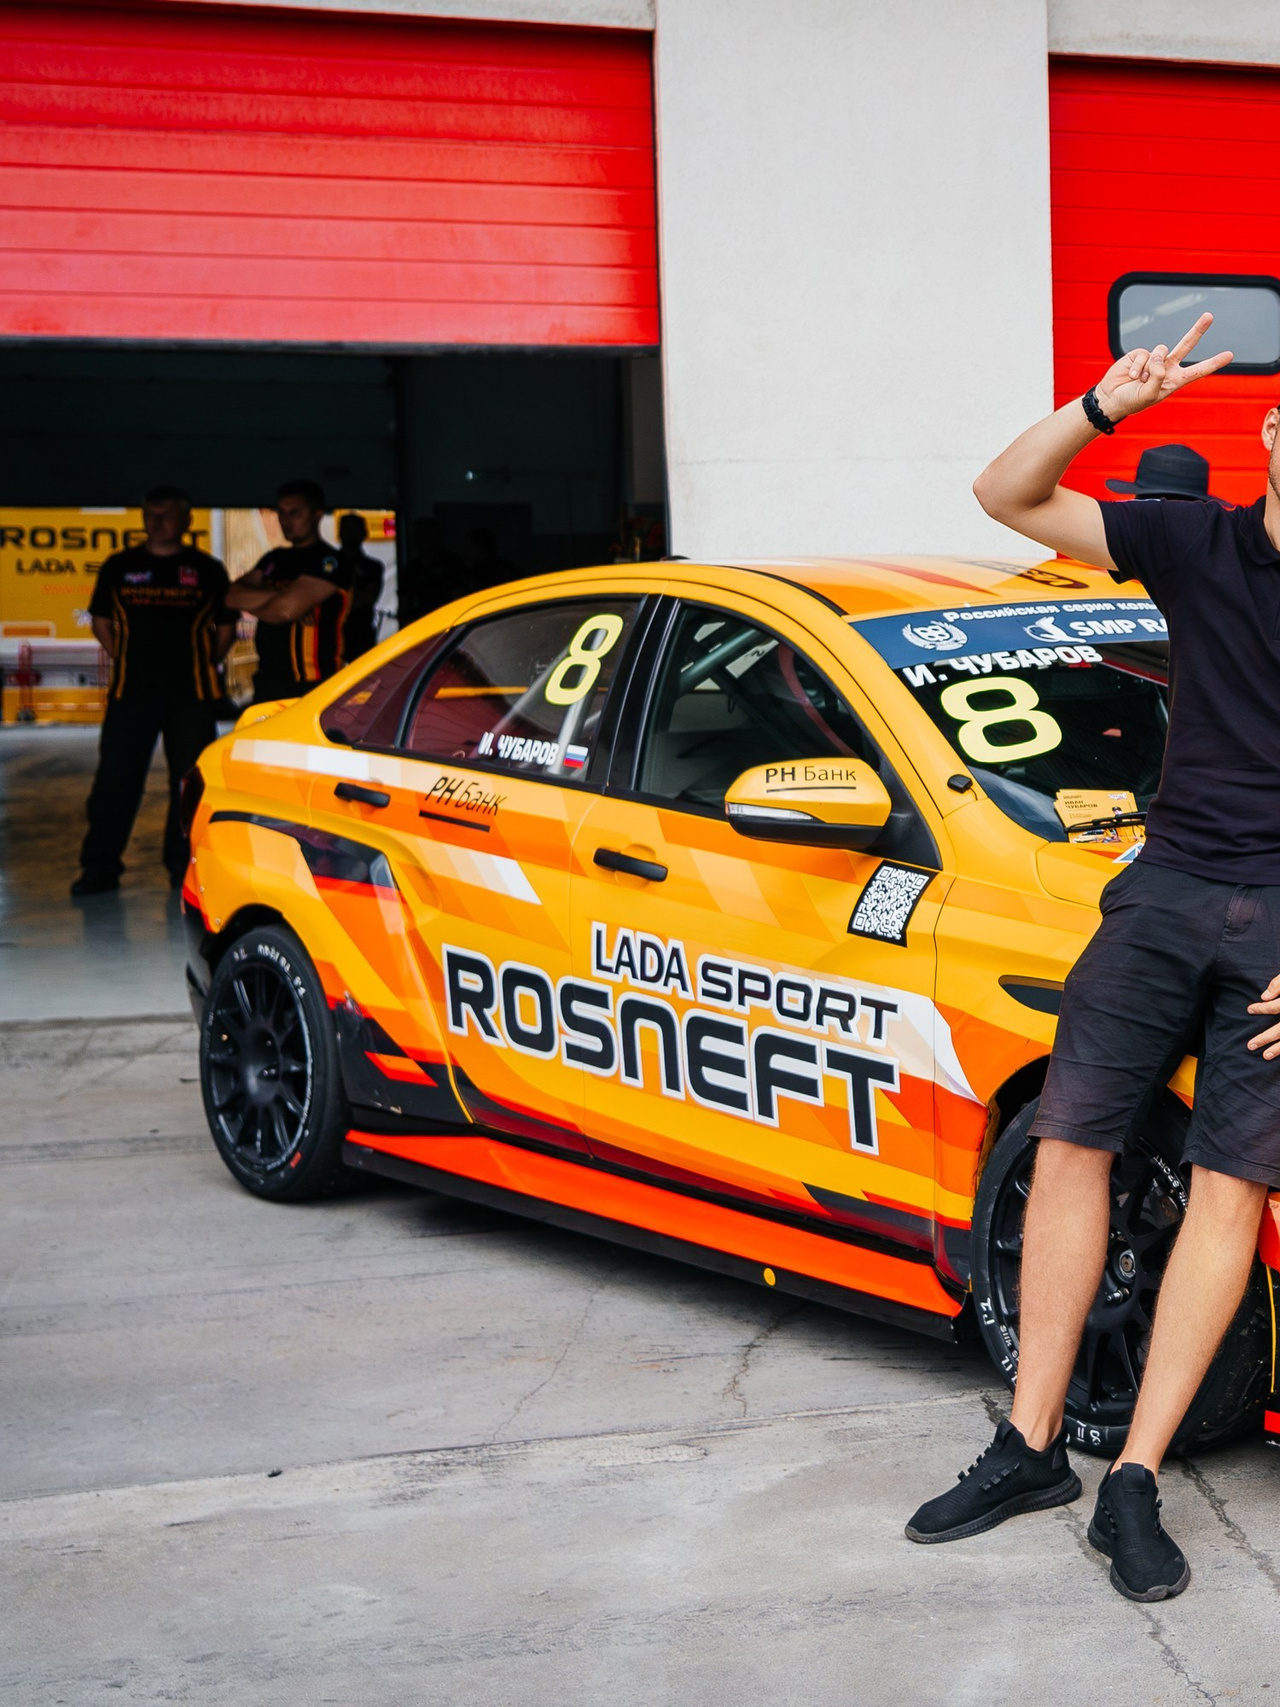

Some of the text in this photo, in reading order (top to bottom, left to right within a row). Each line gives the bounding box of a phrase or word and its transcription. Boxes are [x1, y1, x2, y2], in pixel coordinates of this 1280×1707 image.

[0, 526, 208, 550] ROSNET
[16, 558, 77, 575] LADA
[942, 605, 1060, 622] Российская
[1062, 602, 1116, 613] серия
[1069, 619, 1137, 636] SMP
[545, 613, 624, 706] 8
[902, 645, 1103, 687] И. ЧУБАРОВ
[941, 677, 1062, 763] 8
[478, 731, 560, 766] И. ЧУБАРОВ
[765, 765, 857, 783] РН Банк
[425, 776, 508, 816] РН Банк
[594, 926, 900, 1043] LADA SPORT
[445, 947, 899, 1151] ROSNEFT
